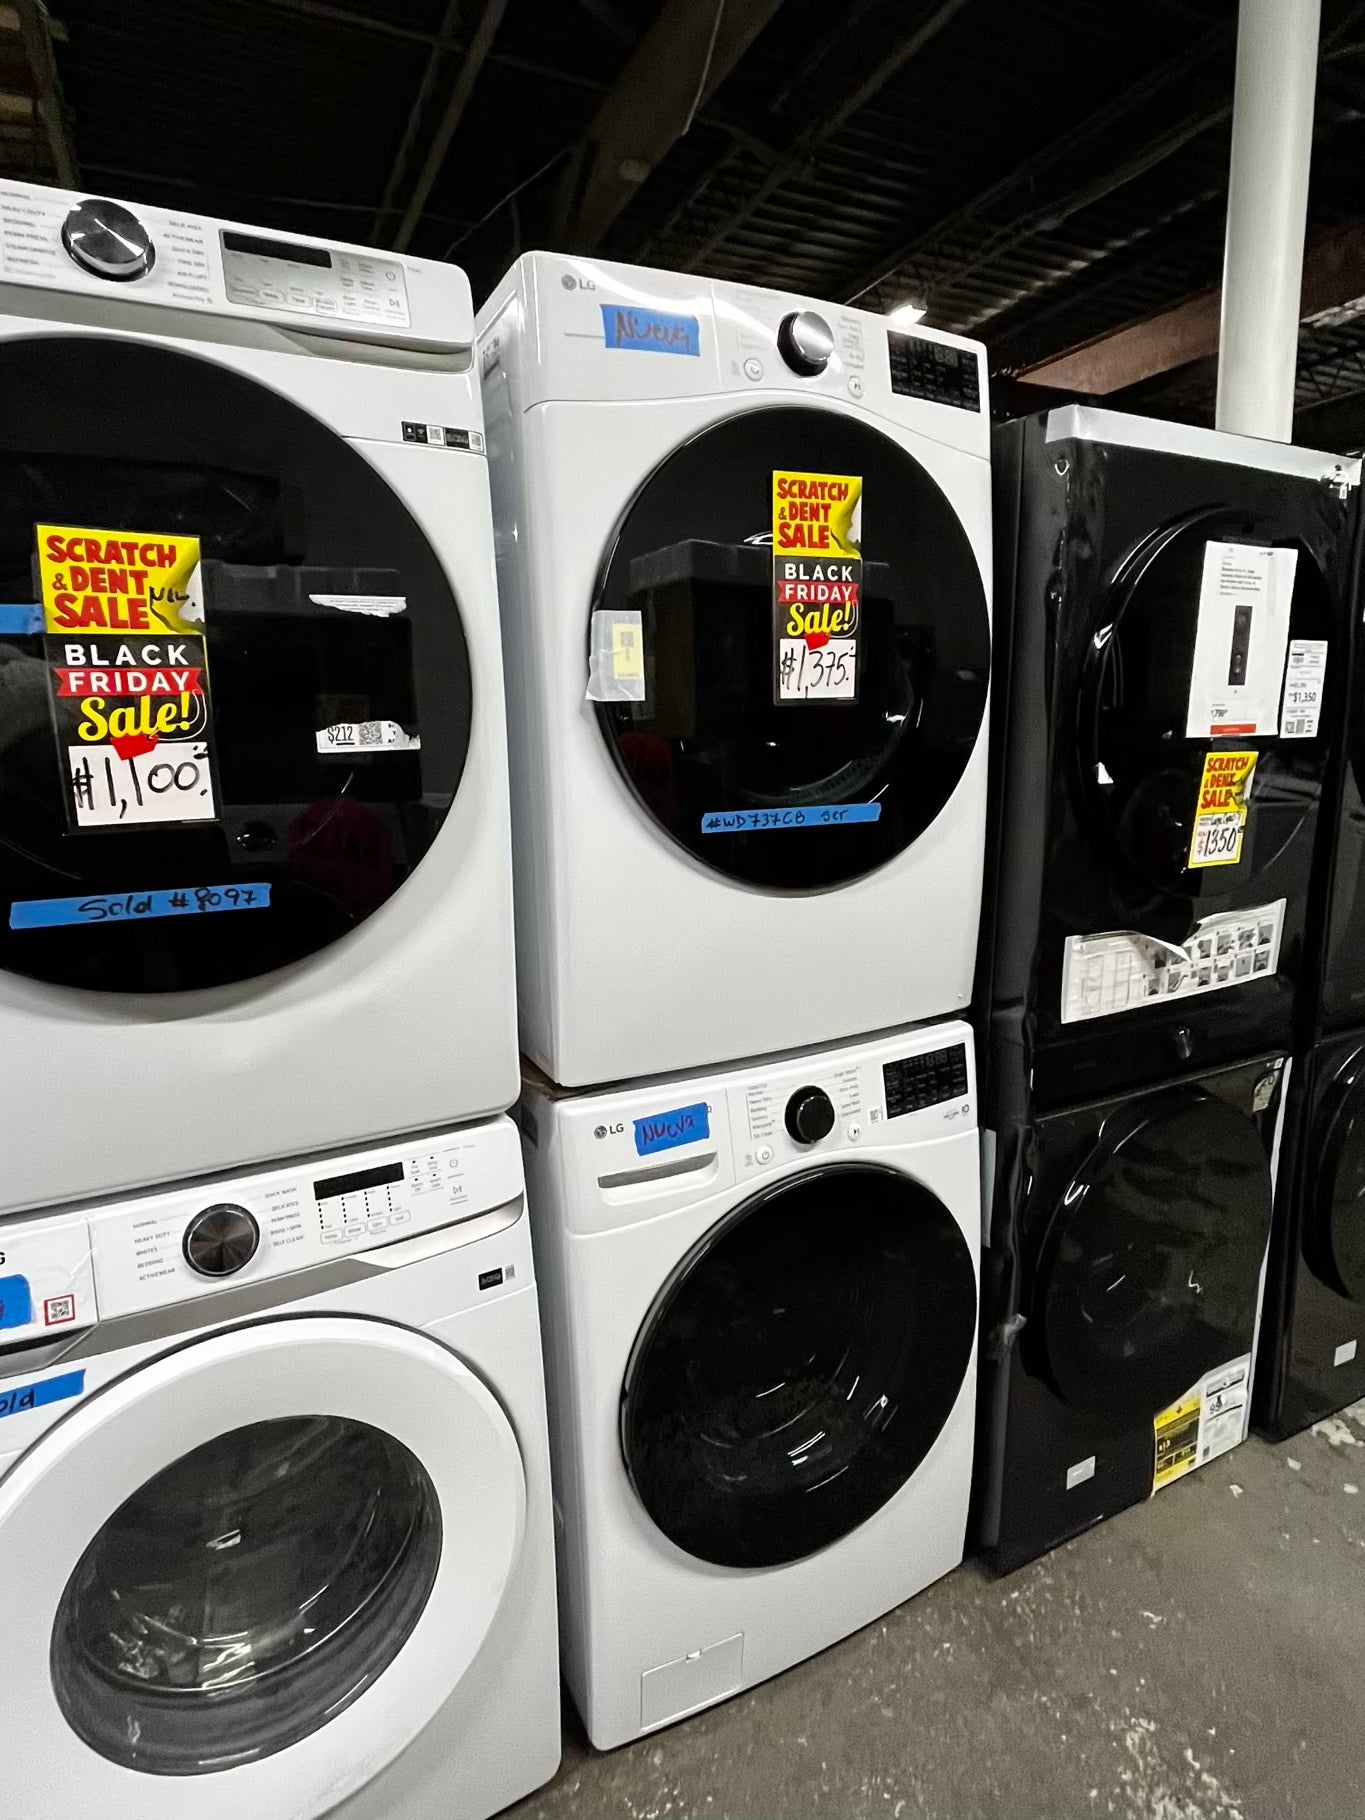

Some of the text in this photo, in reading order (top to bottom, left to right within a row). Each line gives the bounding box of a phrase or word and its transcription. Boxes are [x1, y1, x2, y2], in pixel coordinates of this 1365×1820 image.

[579, 278, 596, 291] LG
[777, 477, 849, 501] SCRATCH
[778, 501, 831, 523] & DENT
[777, 522, 830, 549] SALE
[46, 535, 177, 568] SCRATCH
[52, 573, 68, 591] &
[69, 565, 149, 595] DENT
[784, 563, 853, 582] BLACK
[784, 584, 853, 601] FRIDAY
[54, 593, 151, 630] SALE
[786, 600, 851, 637] Sale!
[64, 644, 189, 666] BLACK
[68, 671, 190, 693] FRIDAY
[77, 691, 190, 742] Sale!
[327, 725, 355, 744] $212
[1206, 757, 1249, 773] SCRATCH
[1210, 773, 1237, 789] DENT
[1200, 789, 1232, 809] SALE
[610, 1123, 625, 1135] LG
[134, 1231, 170, 1244] HEAVY DUTY
